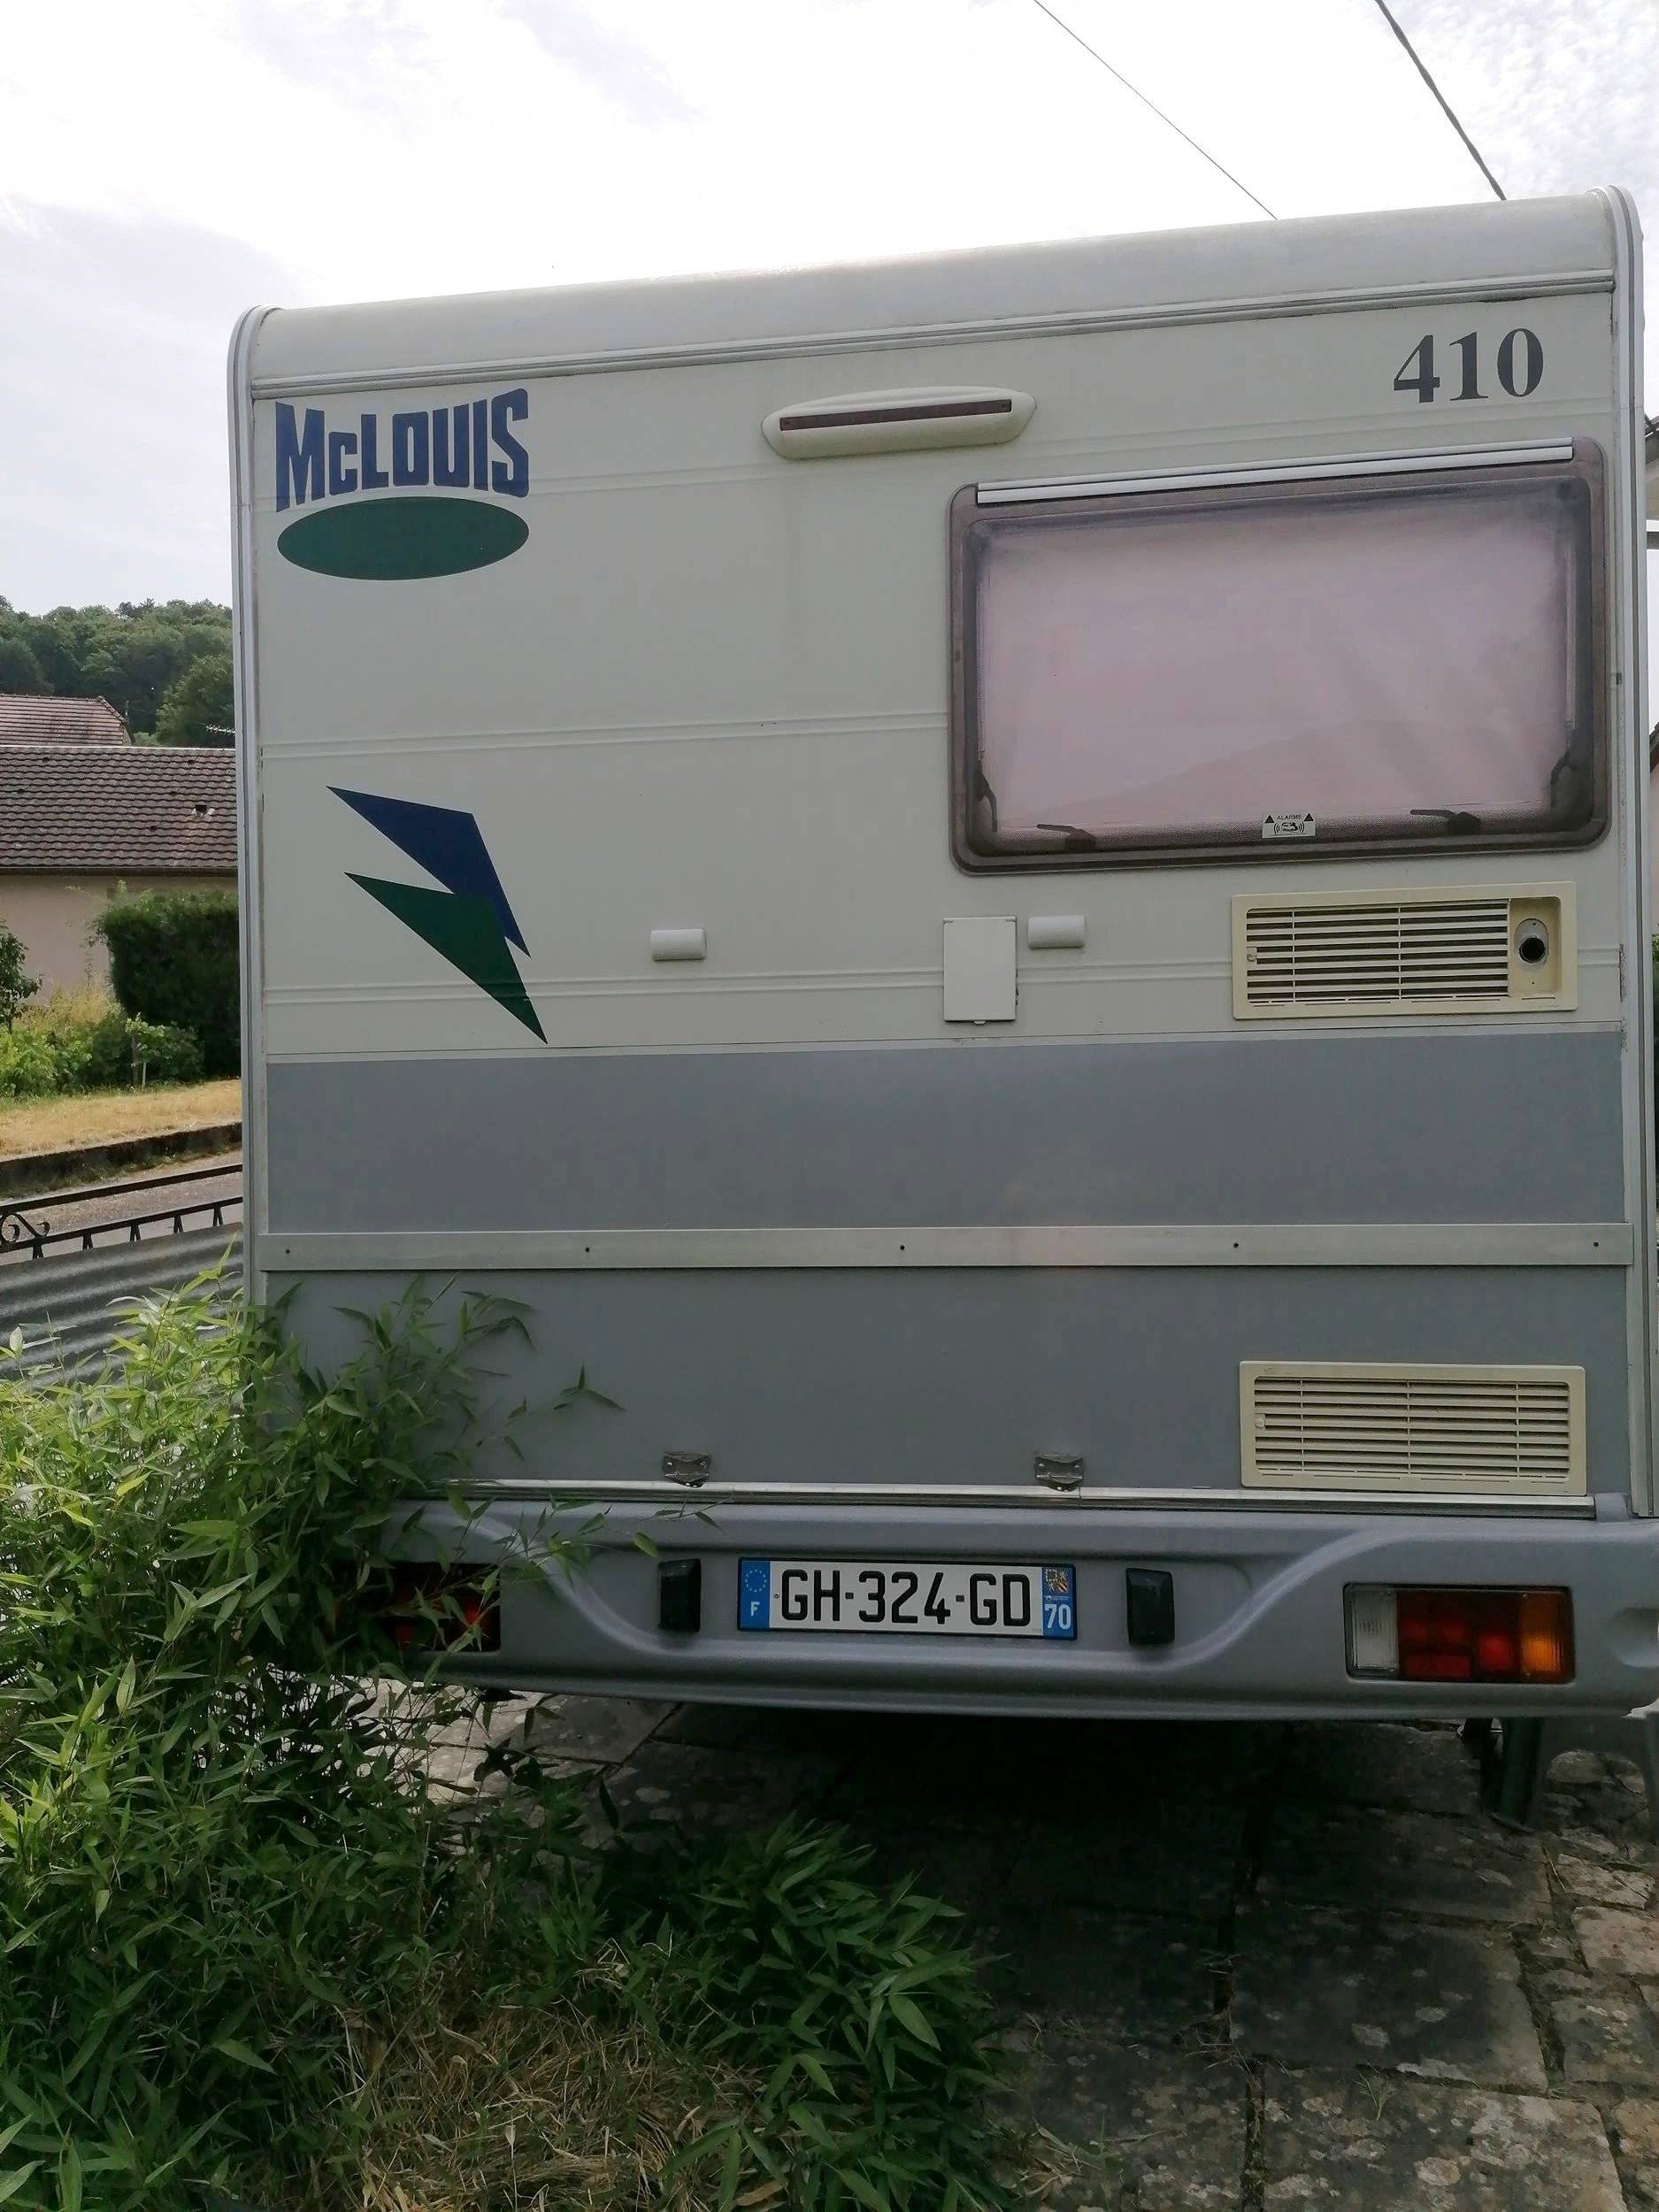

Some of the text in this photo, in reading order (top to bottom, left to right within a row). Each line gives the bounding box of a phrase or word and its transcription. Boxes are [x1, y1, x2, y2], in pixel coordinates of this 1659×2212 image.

[1394, 328, 1544, 403] 410
[275, 388, 529, 512] McLOUIS
[749, 1569, 1071, 1631] F GH-324-GD 70
